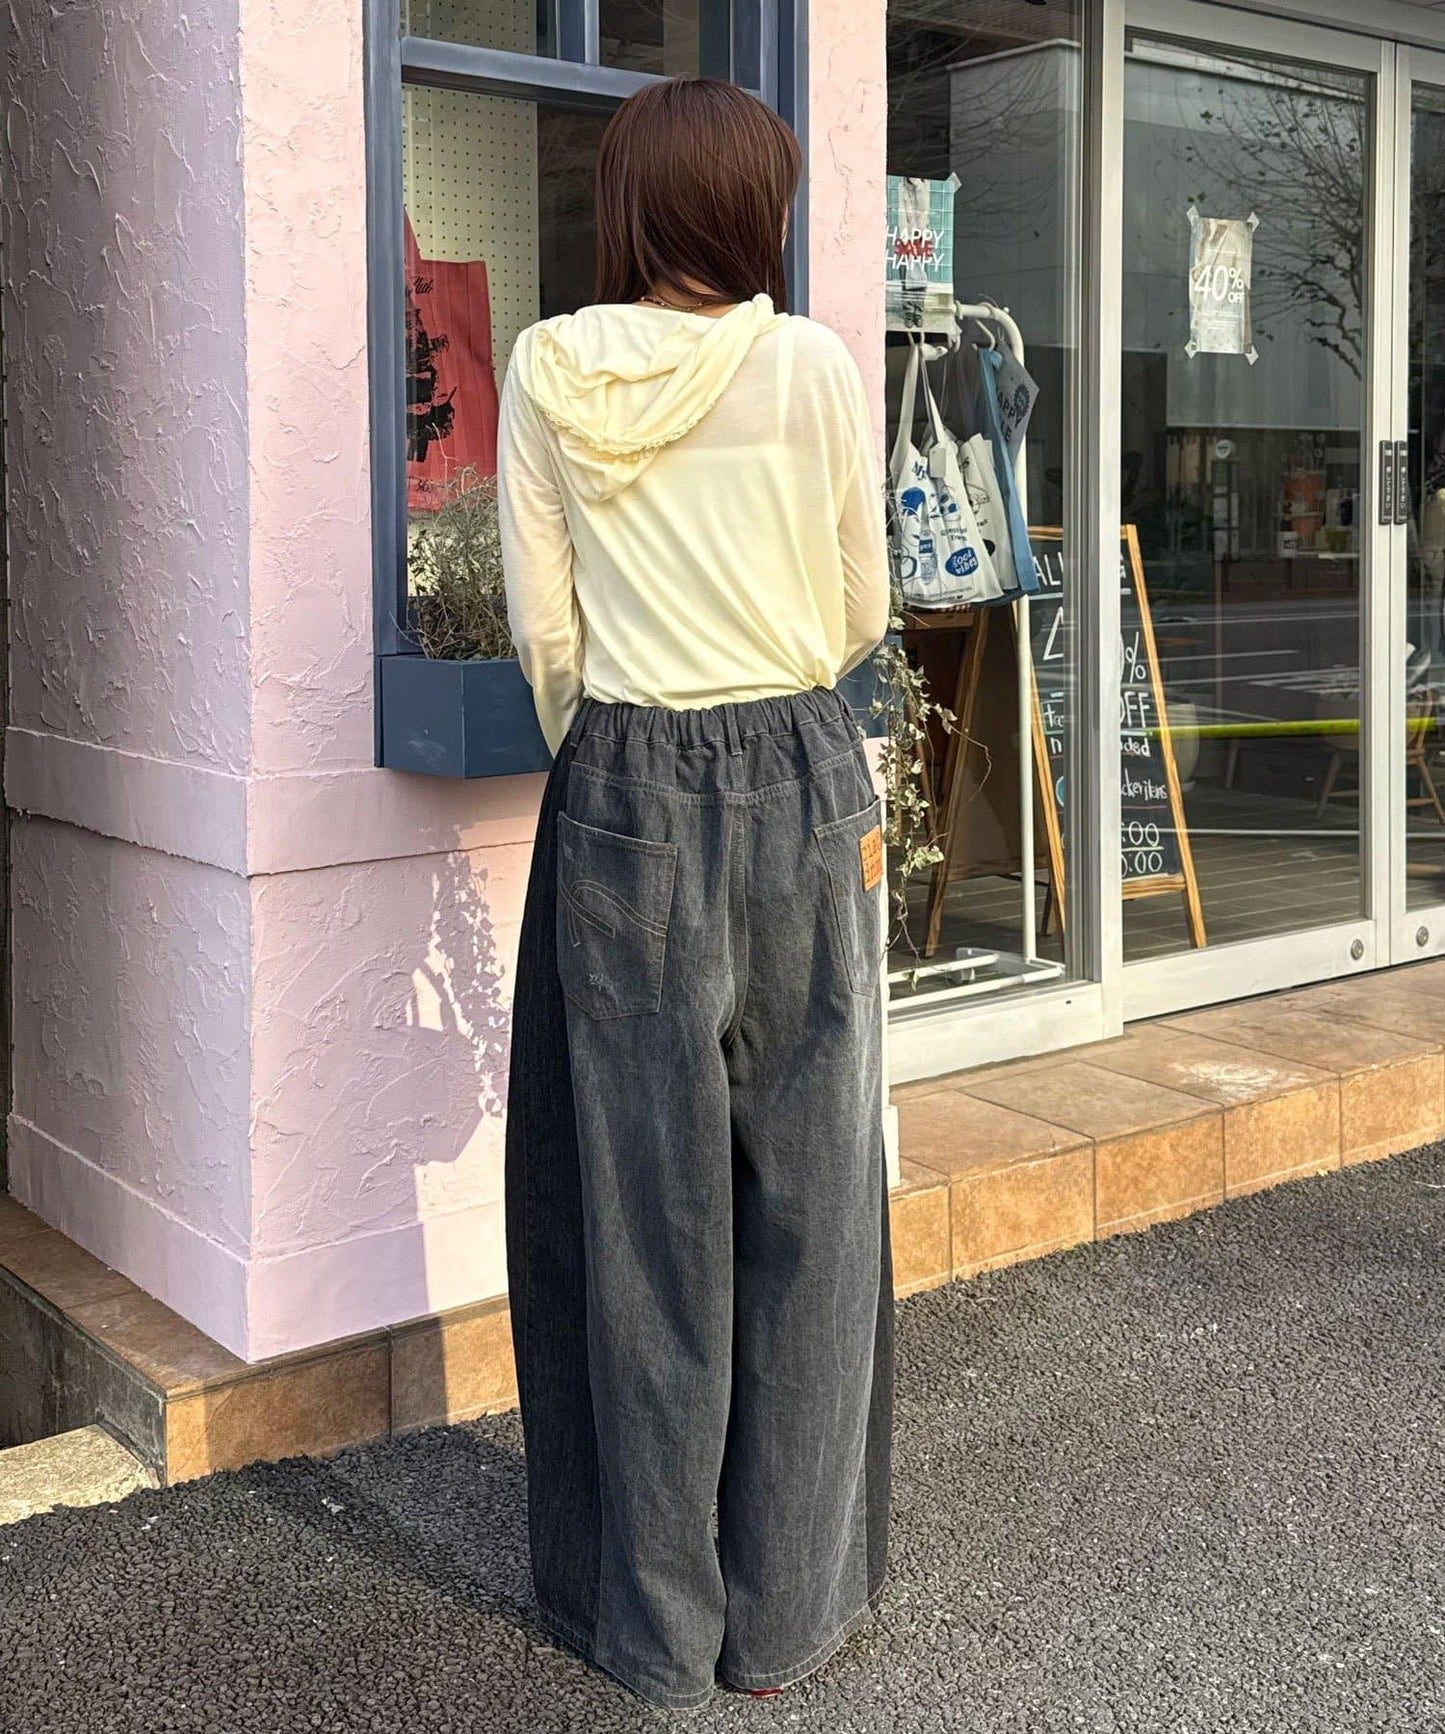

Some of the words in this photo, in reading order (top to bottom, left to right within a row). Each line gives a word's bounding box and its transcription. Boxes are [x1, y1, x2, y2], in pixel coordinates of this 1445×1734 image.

[886, 226, 945, 249] HAPPY
[886, 249, 945, 273] HAPPY
[1228, 292, 1245, 304] OFF
